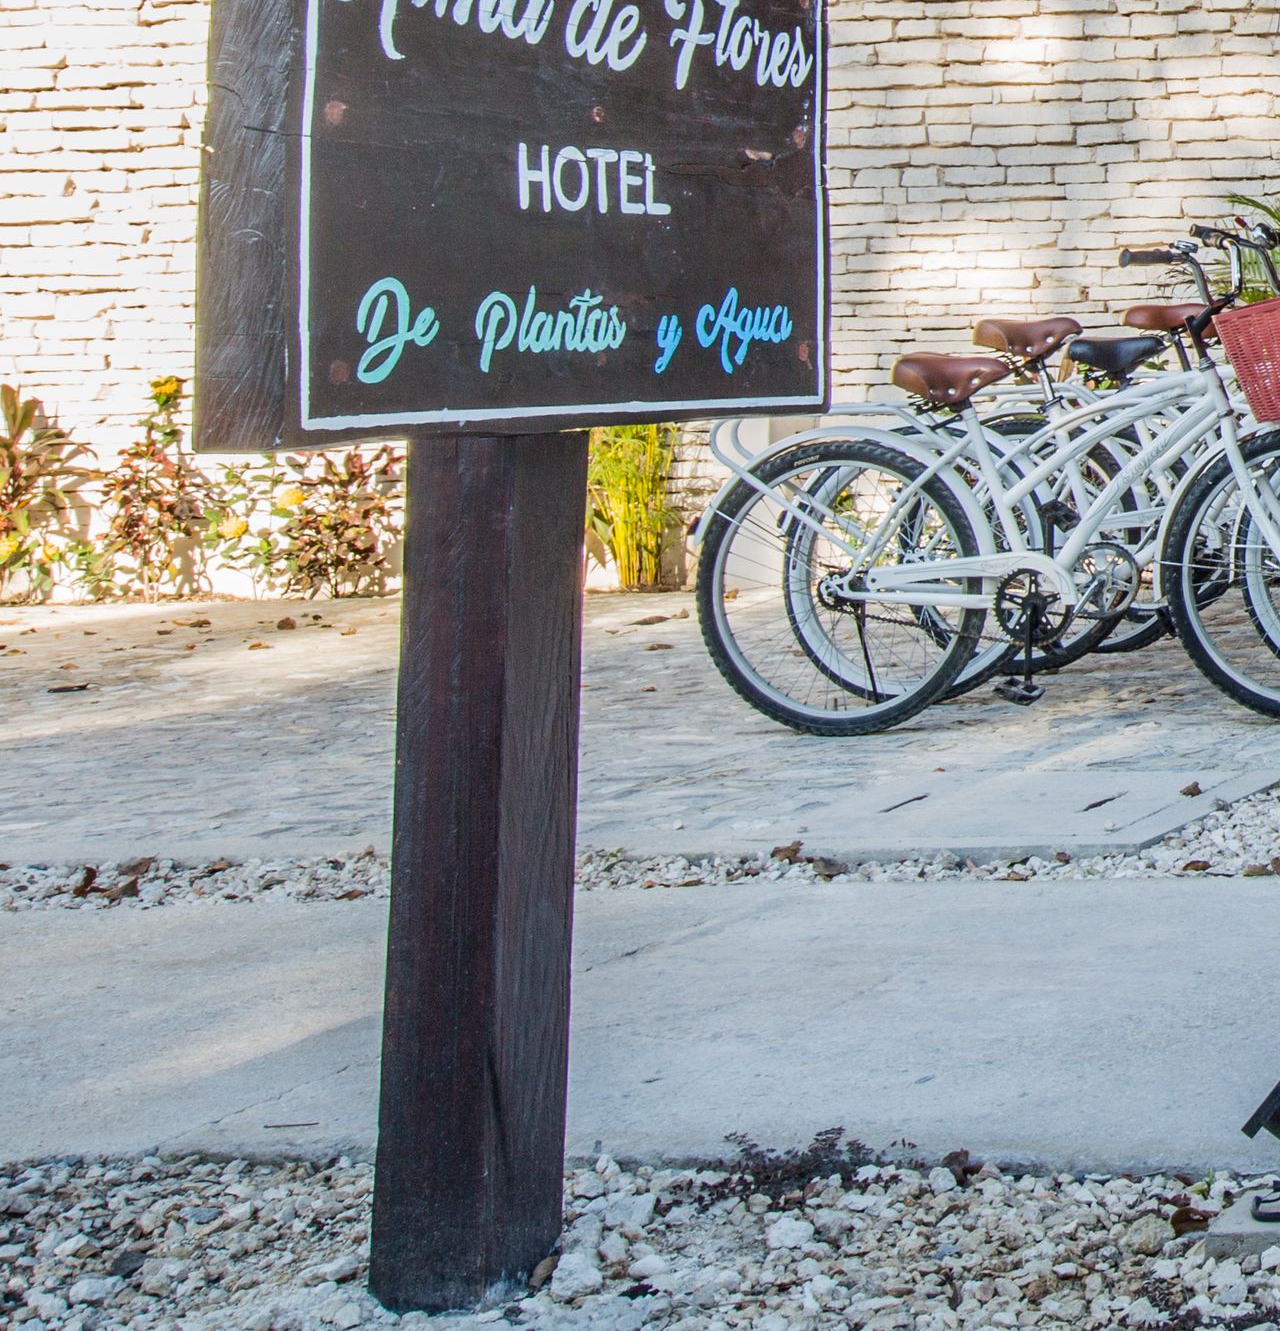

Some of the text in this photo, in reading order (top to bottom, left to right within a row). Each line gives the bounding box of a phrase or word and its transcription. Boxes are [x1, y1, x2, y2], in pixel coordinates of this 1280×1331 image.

[516, 142, 671, 215] HOTEL
[357, 277, 792, 383] De Plantas y Agua
